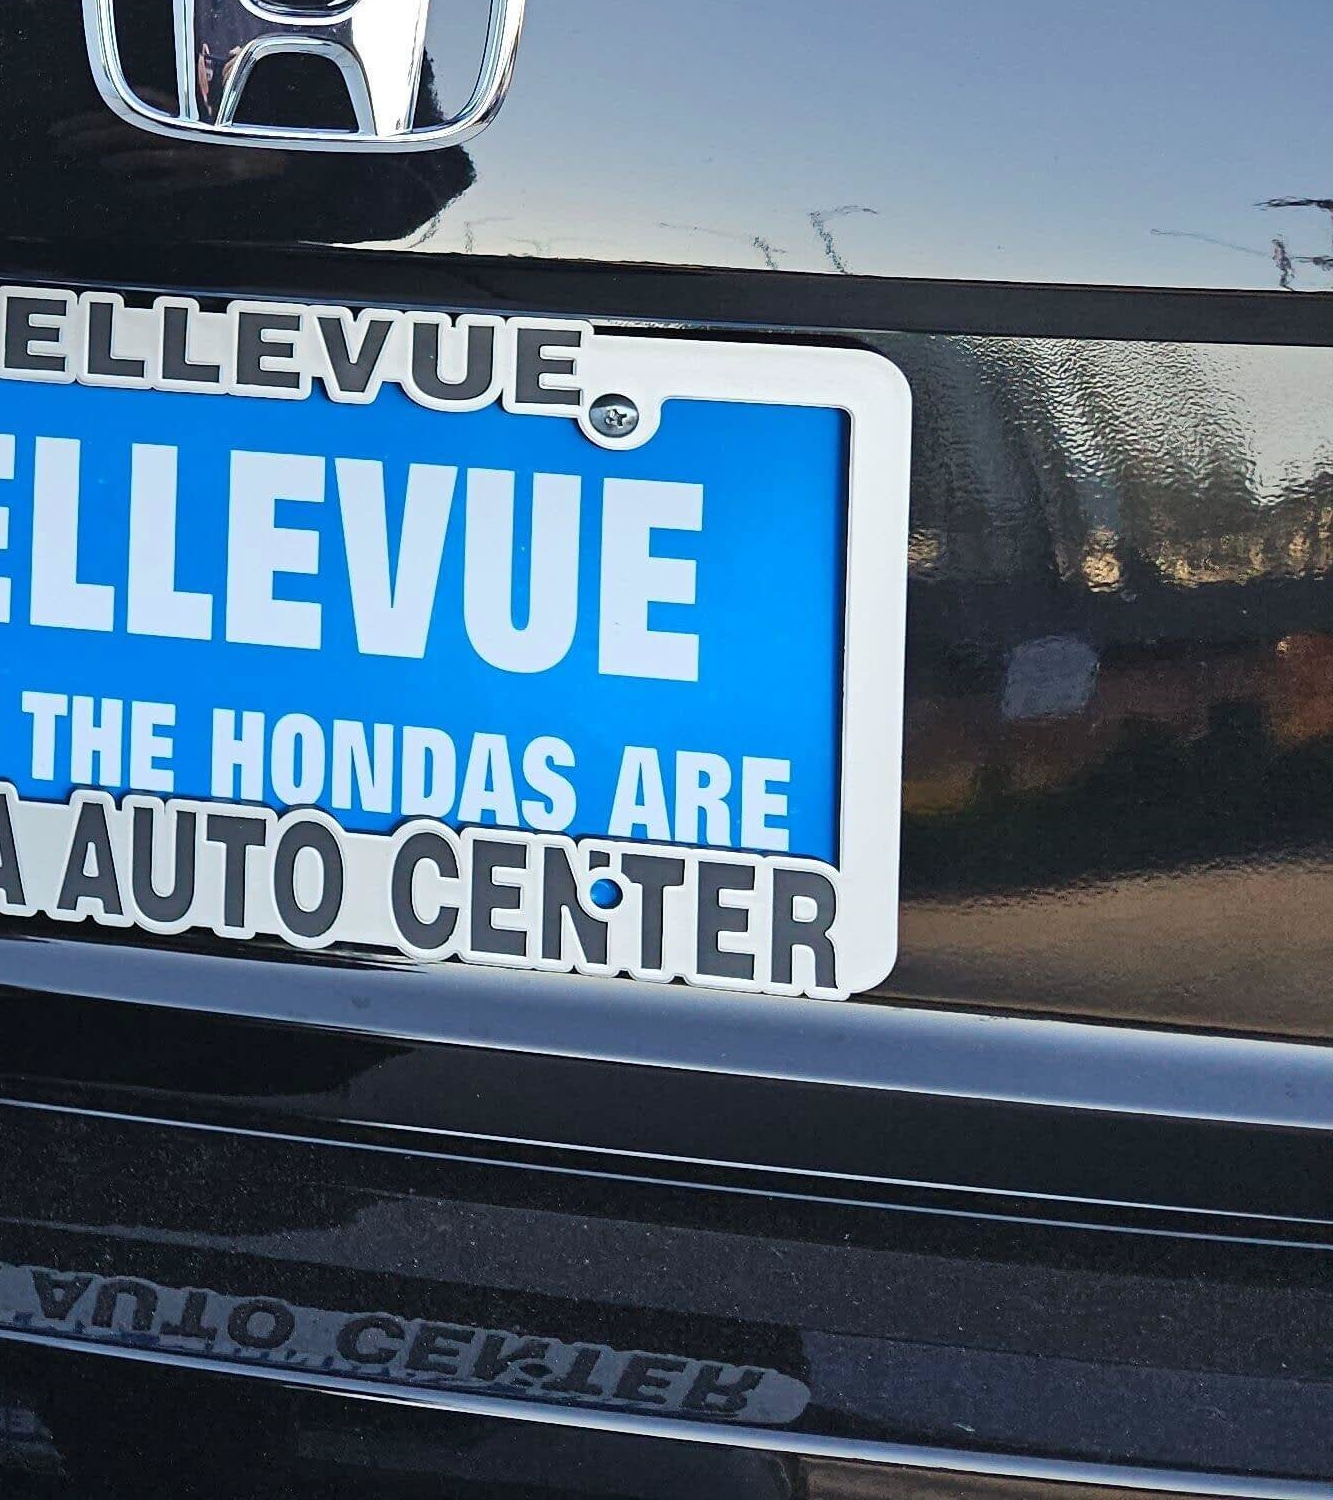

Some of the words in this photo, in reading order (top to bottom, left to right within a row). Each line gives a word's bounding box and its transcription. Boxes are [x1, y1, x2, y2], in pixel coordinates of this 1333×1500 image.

[22, 691, 174, 793] THE
[210, 711, 577, 832] HONDAS
[610, 746, 791, 850] ARE
[56, 799, 342, 944] AUTO
[391, 834, 839, 988] CENTER
